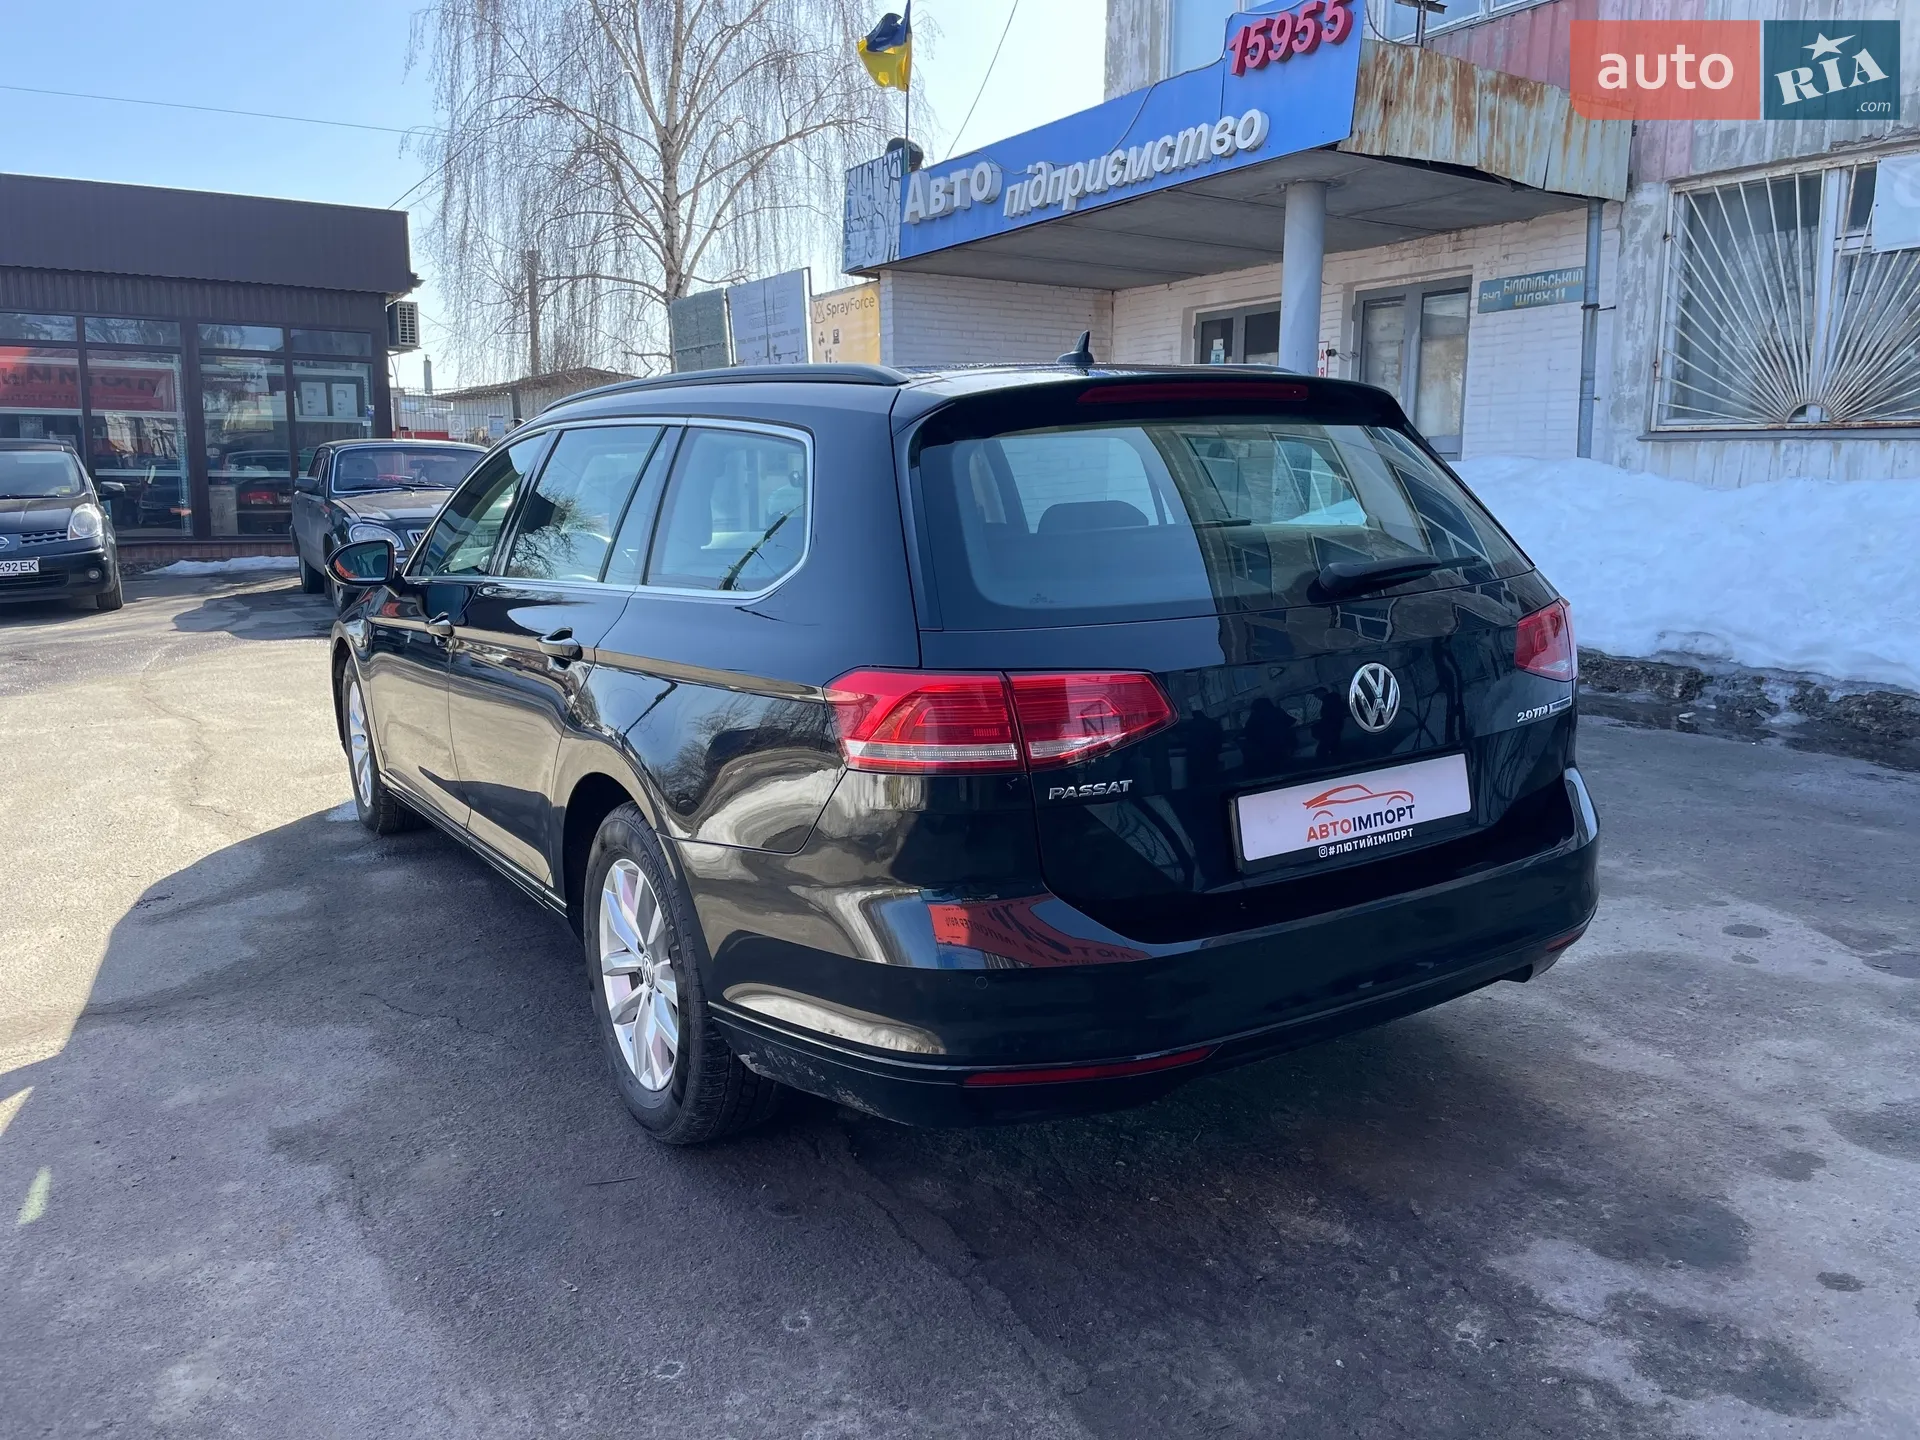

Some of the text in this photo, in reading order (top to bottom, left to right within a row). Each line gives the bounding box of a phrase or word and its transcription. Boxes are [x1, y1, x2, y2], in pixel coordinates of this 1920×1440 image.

[1229, 0, 1354, 76] 15955
[902, 108, 1270, 225] Авто підприємство
[826, 296, 875, 318] SprayForce
[1048, 779, 1133, 800] PASSAT
[1307, 804, 1415, 842] АВТОІМПОРТ
[1328, 828, 1414, 855] #ЛЮТИЙІМПОРТ
